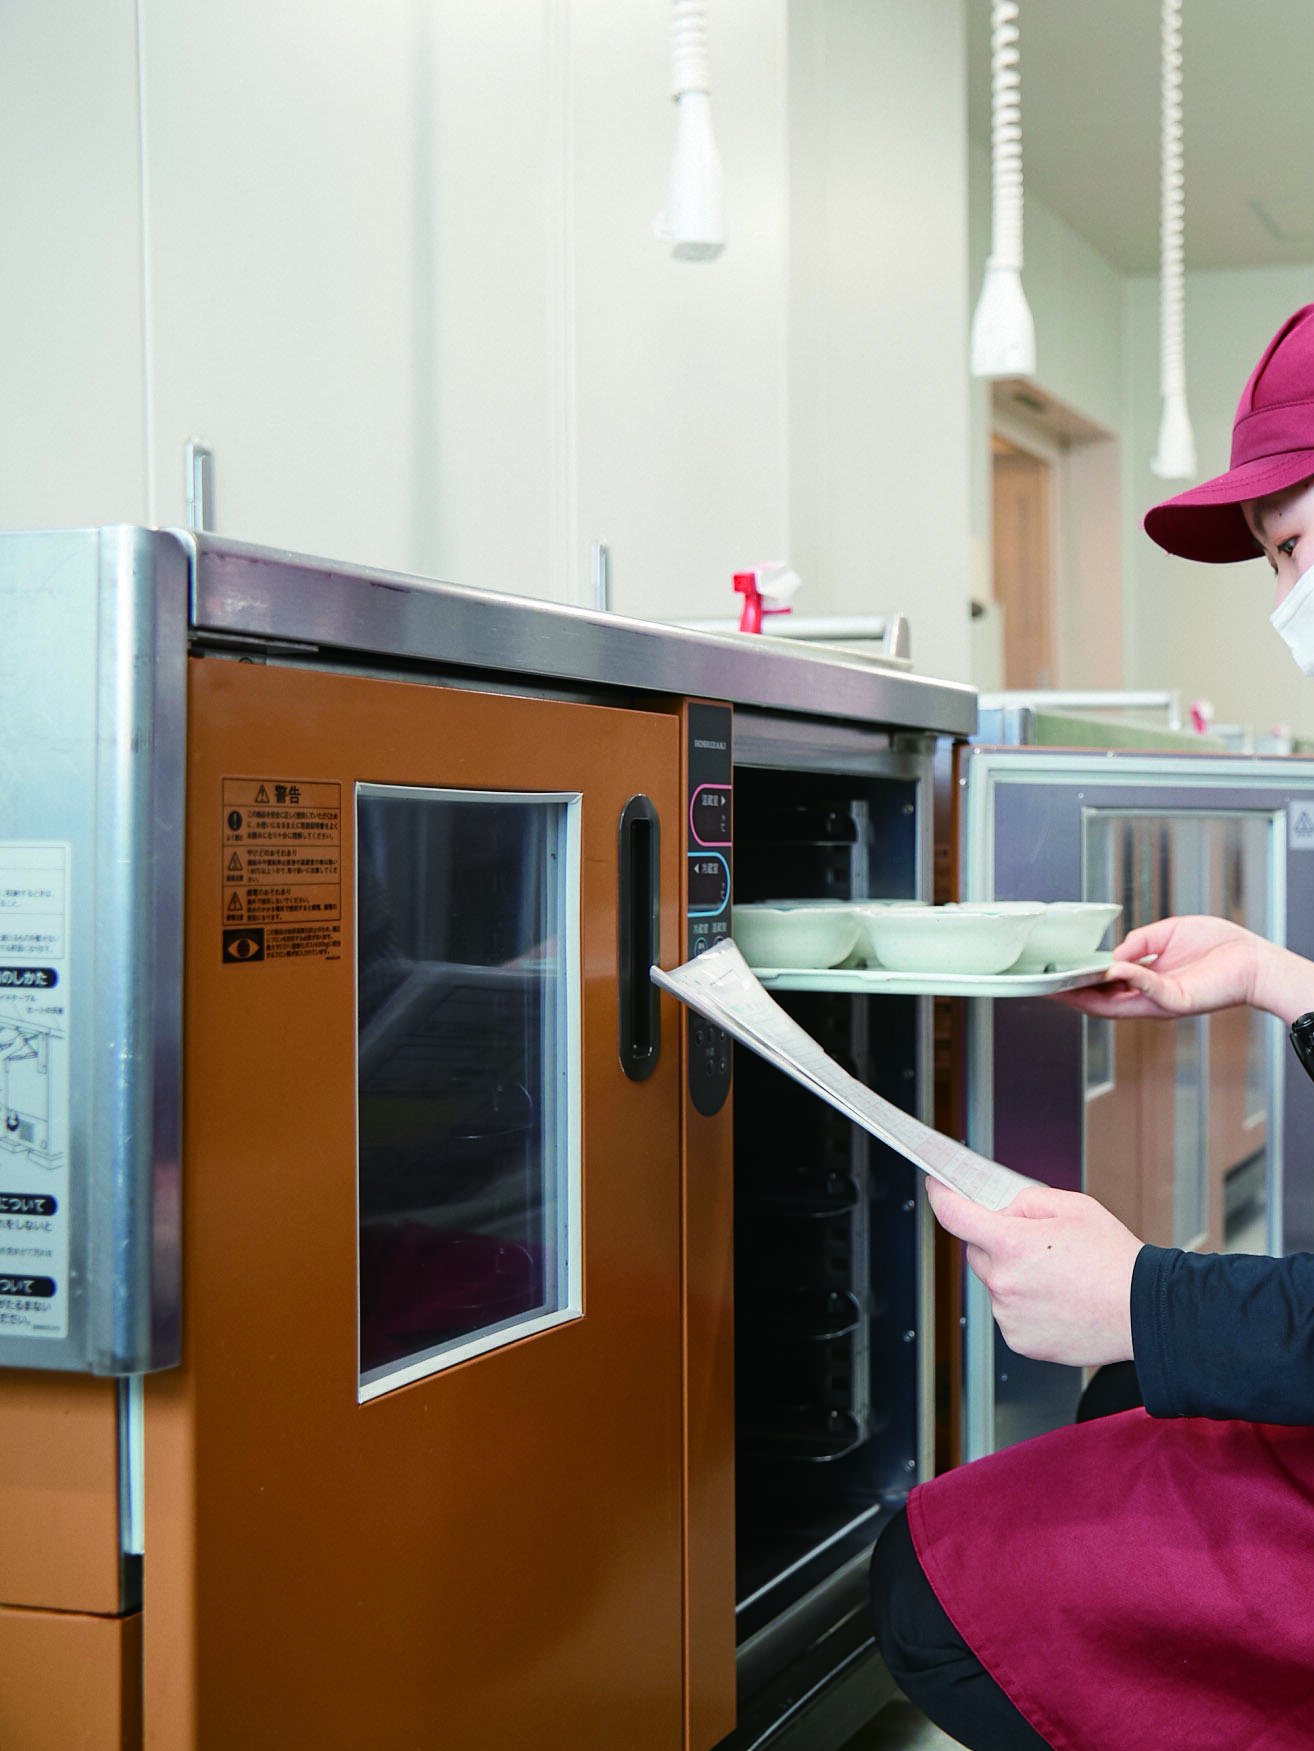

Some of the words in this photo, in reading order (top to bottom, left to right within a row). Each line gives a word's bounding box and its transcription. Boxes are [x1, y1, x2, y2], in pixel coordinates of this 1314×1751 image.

[274, 785, 301, 804] 警告
[0, 970, 48, 985] のしかた
